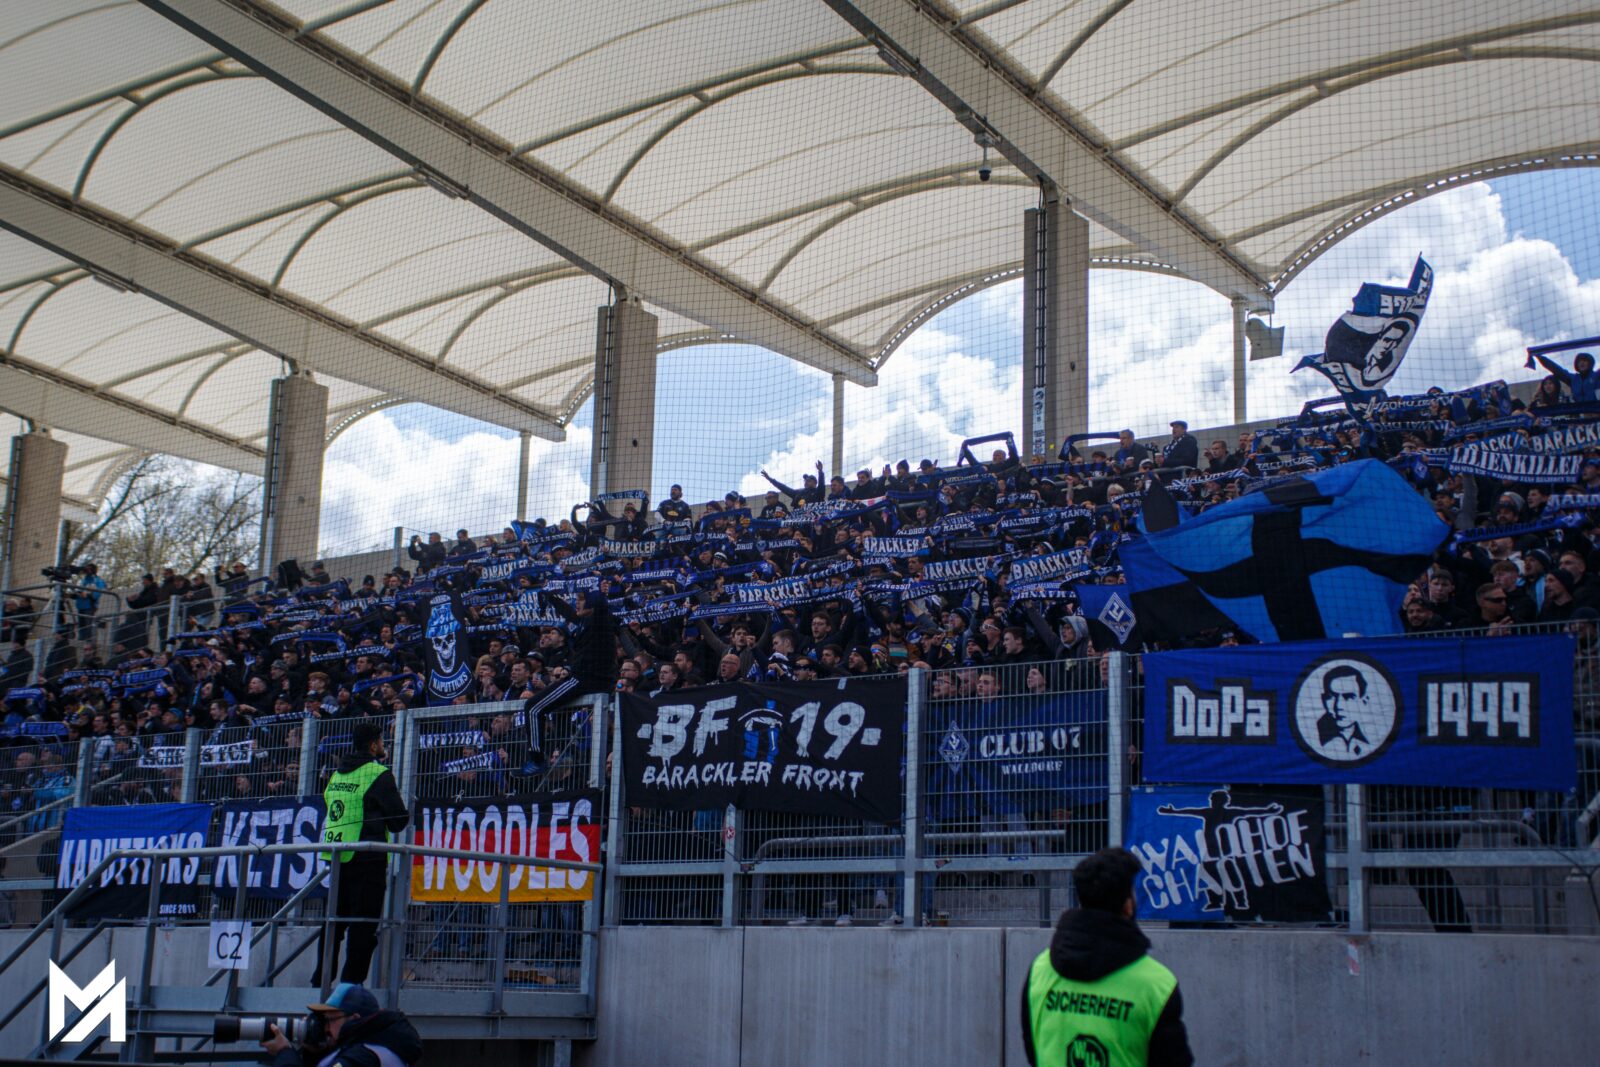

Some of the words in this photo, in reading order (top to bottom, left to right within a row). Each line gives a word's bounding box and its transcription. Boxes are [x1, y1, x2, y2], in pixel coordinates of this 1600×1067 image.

[1451, 447, 1583, 475] LILIENKILLER
[604, 540, 656, 555] BARACKLER
[1013, 549, 1083, 580] BARACKLER
[1426, 681, 1531, 738] 1999
[979, 729, 1046, 758] CLUB
[1052, 727, 1081, 750] 07
[642, 761, 772, 790] BARACKLER
[782, 763, 864, 798] FRONT
[214, 805, 332, 890] KETS
[422, 799, 593, 893] WOODLES
[160, 904, 177, 914] SINCE
[178, 903, 196, 914] 2011
[216, 932, 242, 960] C2
[1046, 990, 1134, 1022] SICHERHEIT
